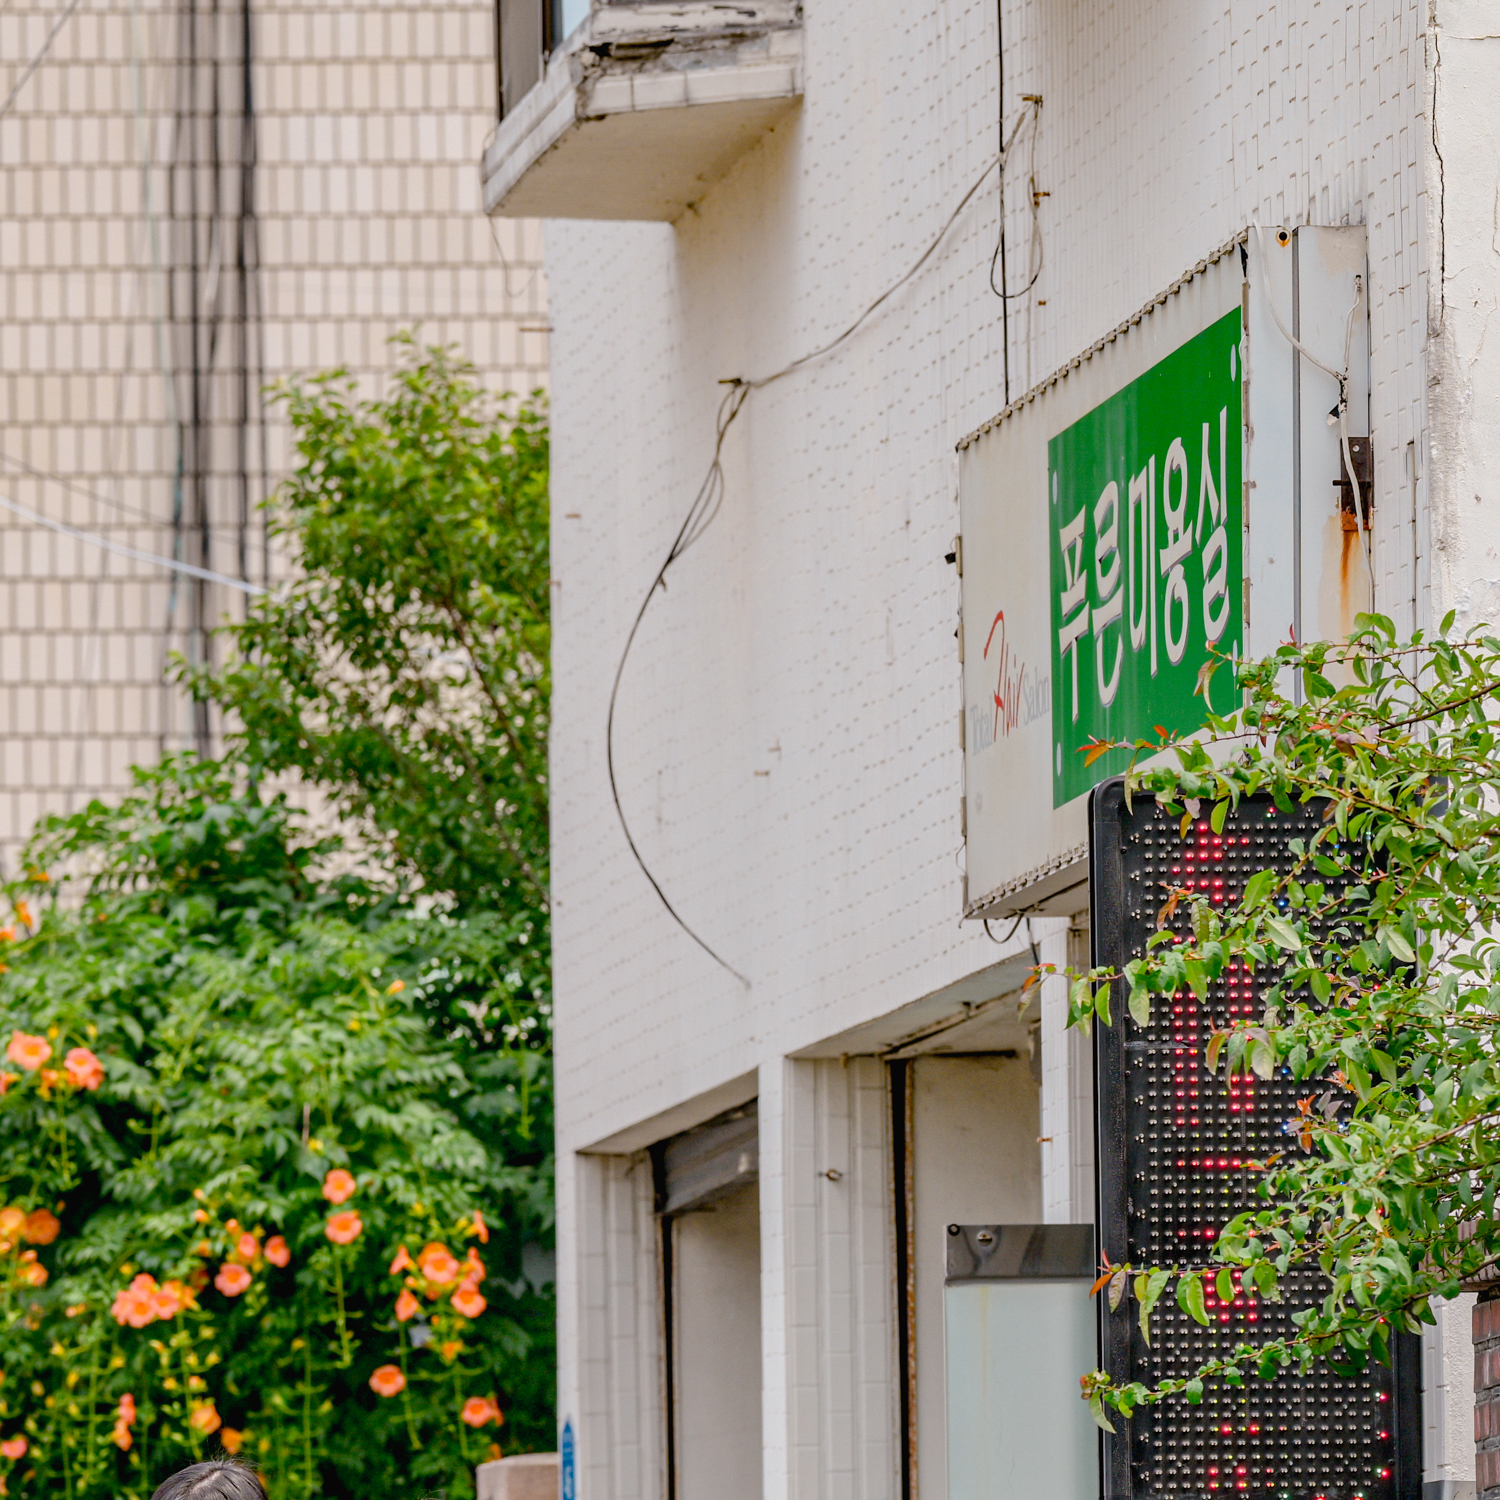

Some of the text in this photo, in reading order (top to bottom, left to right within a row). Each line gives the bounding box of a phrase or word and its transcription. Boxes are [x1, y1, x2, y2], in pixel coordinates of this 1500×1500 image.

[1059, 405, 1230, 724] 푸른미용실
[969, 610, 1051, 757] Total Hair Salon
